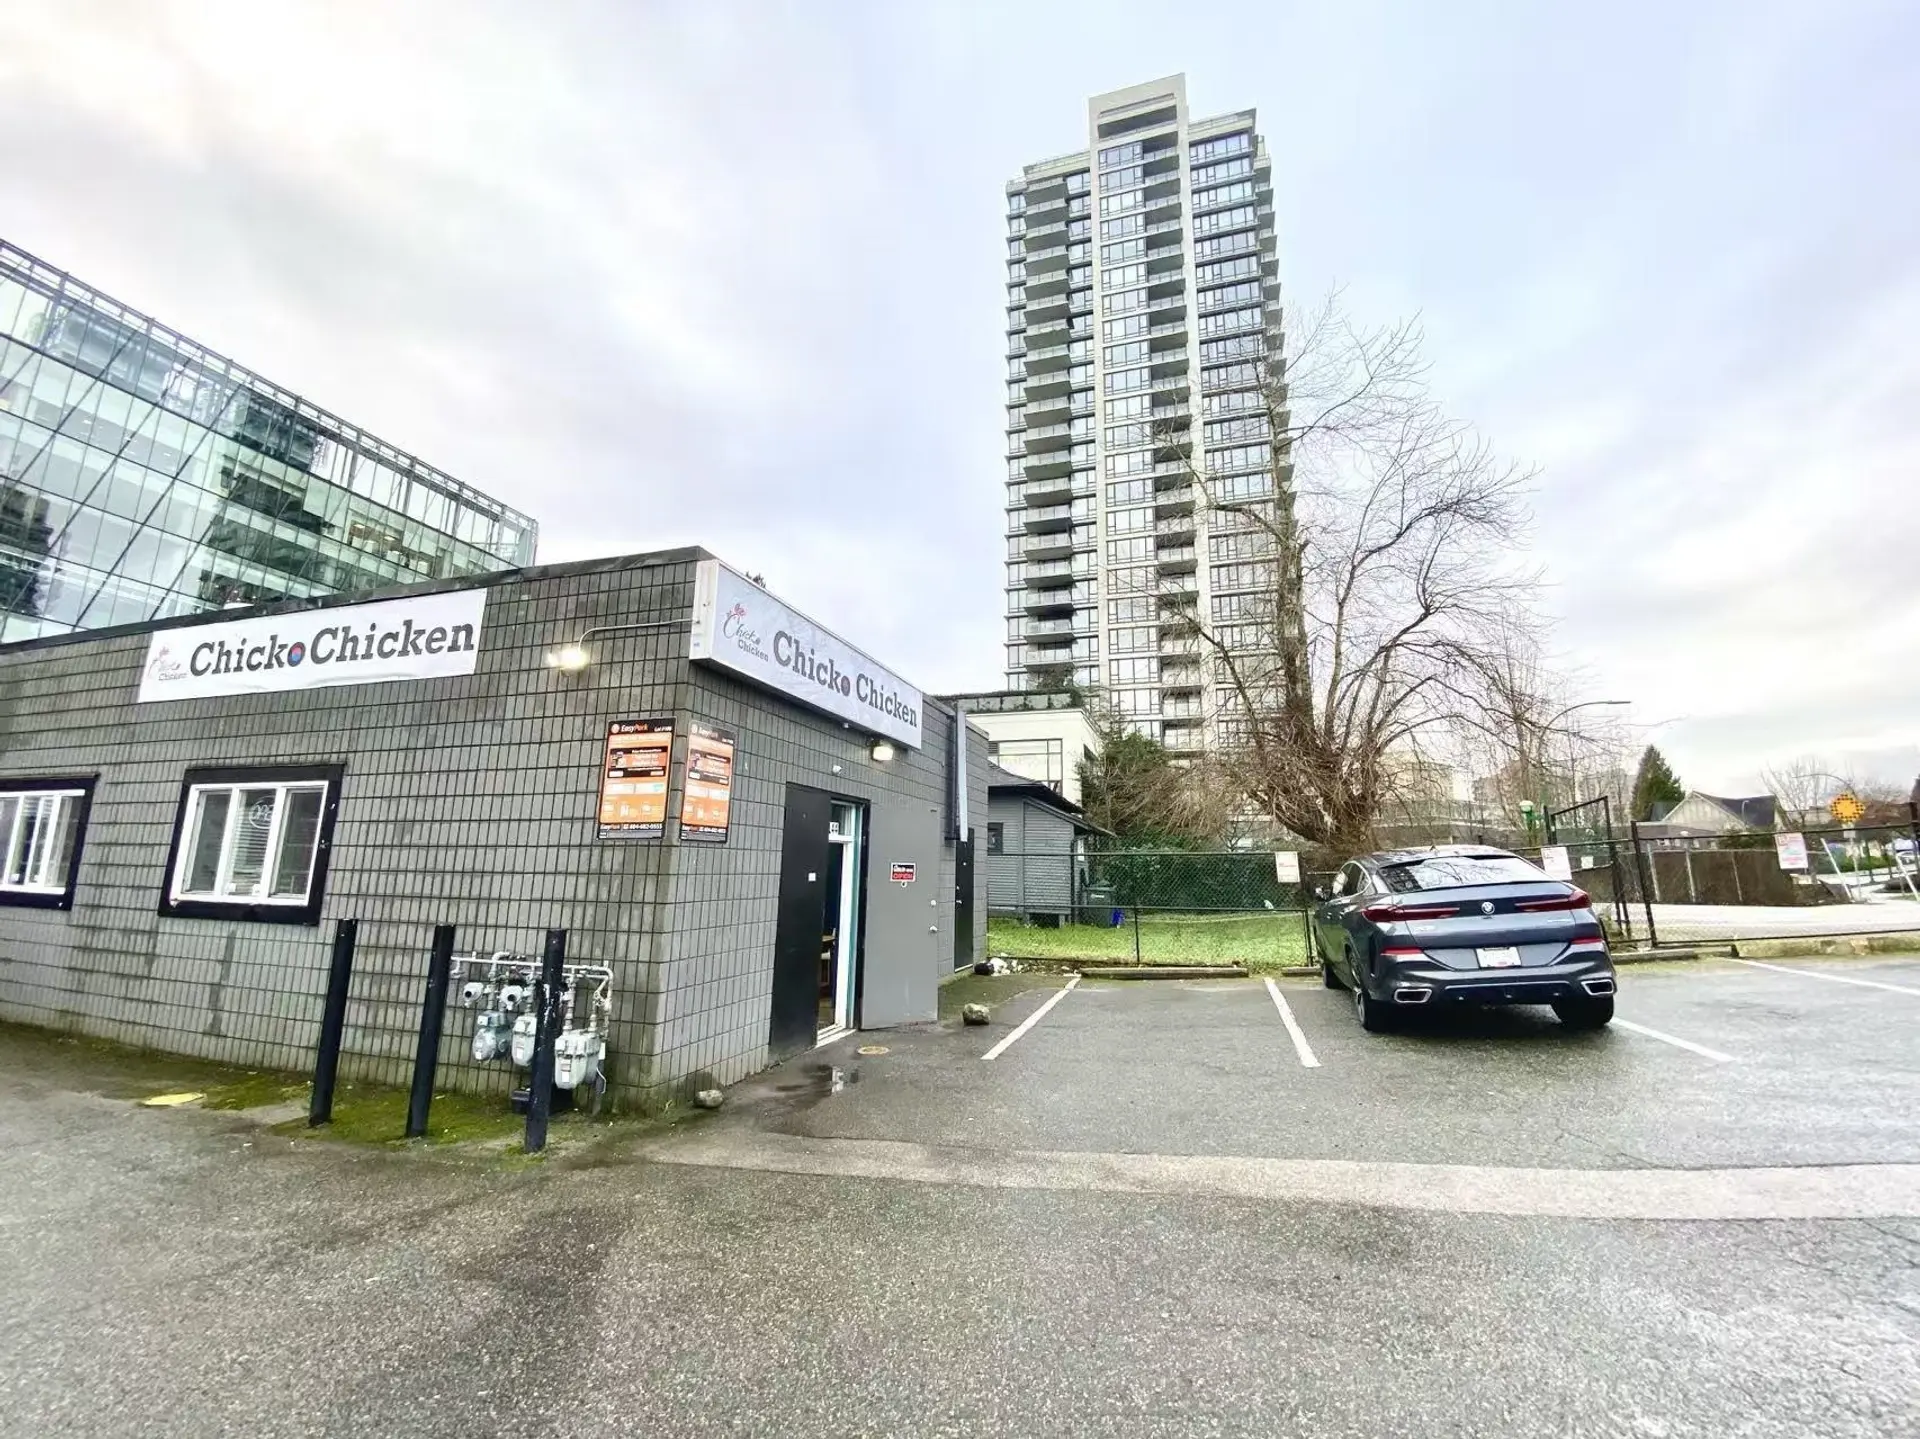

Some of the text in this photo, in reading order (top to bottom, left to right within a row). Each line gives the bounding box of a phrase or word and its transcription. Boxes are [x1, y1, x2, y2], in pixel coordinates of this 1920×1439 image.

[189, 619, 475, 677] Chicko Chicken
[738, 639, 769, 662] Chicken
[773, 630, 918, 728] Chicko Chicken
[621, 724, 648, 733] EasyPark
